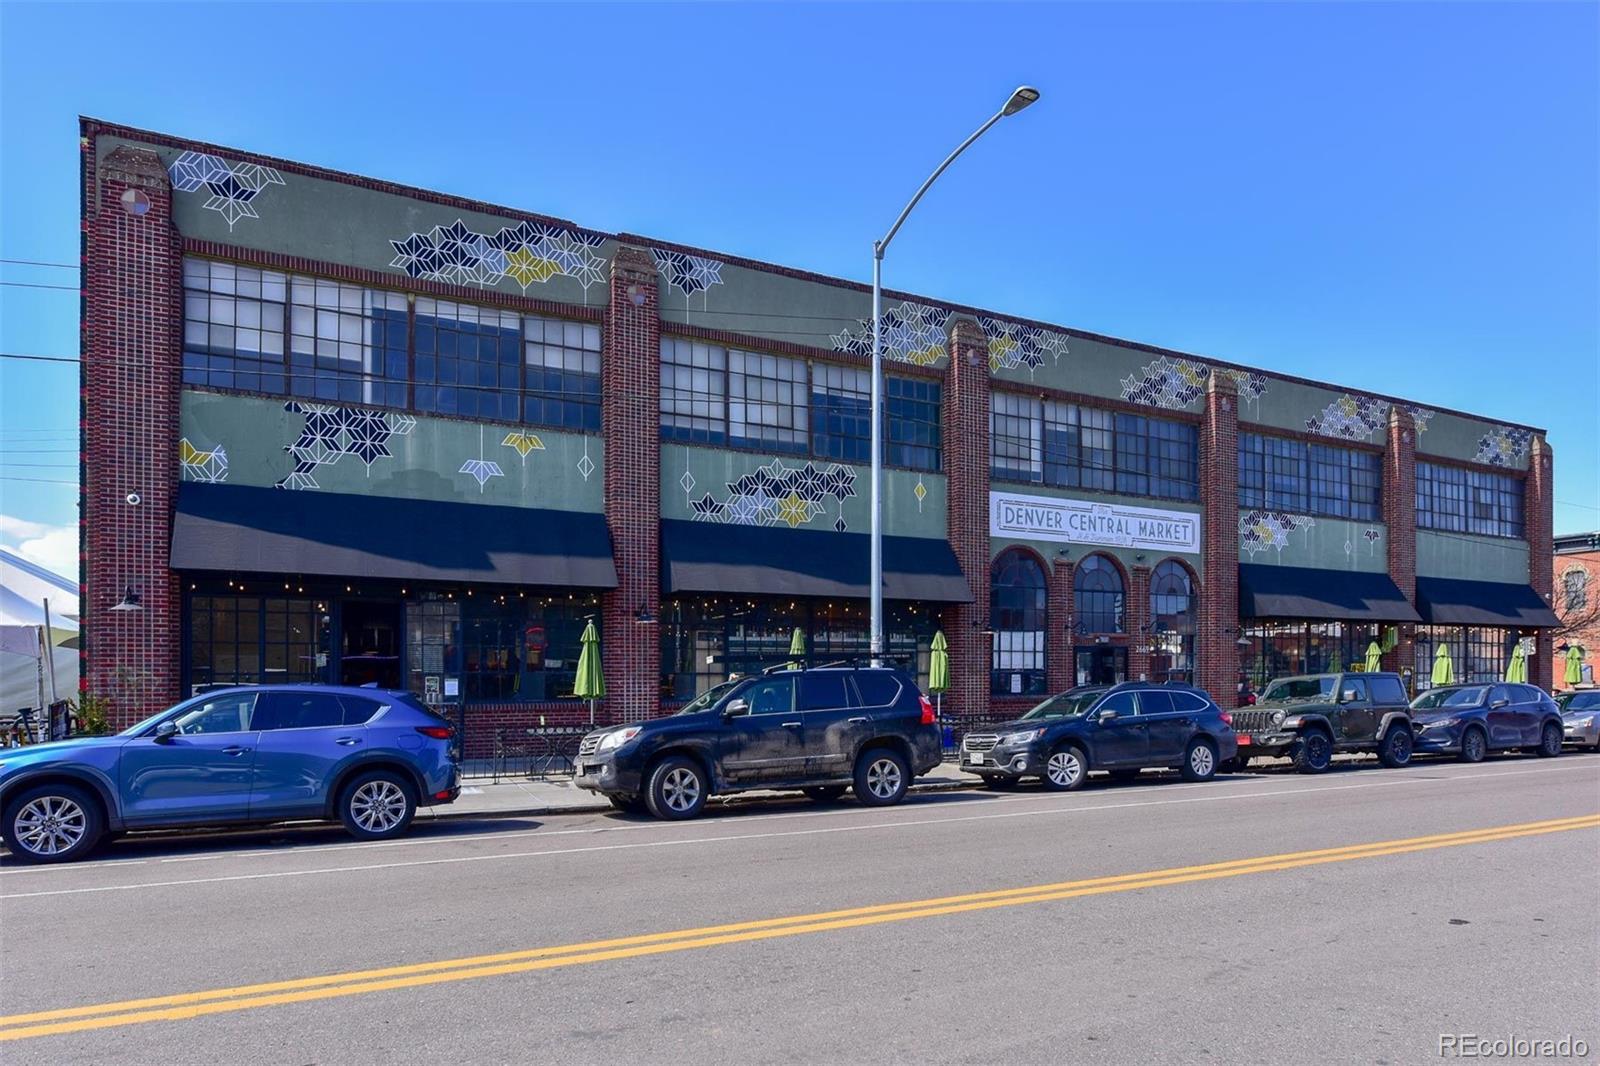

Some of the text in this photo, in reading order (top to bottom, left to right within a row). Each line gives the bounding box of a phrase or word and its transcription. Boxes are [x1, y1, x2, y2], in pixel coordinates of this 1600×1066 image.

[1005, 506, 1062, 529] DENVER
[1069, 513, 1131, 536] CENTRAL
[1138, 520, 1190, 541] MARKET
